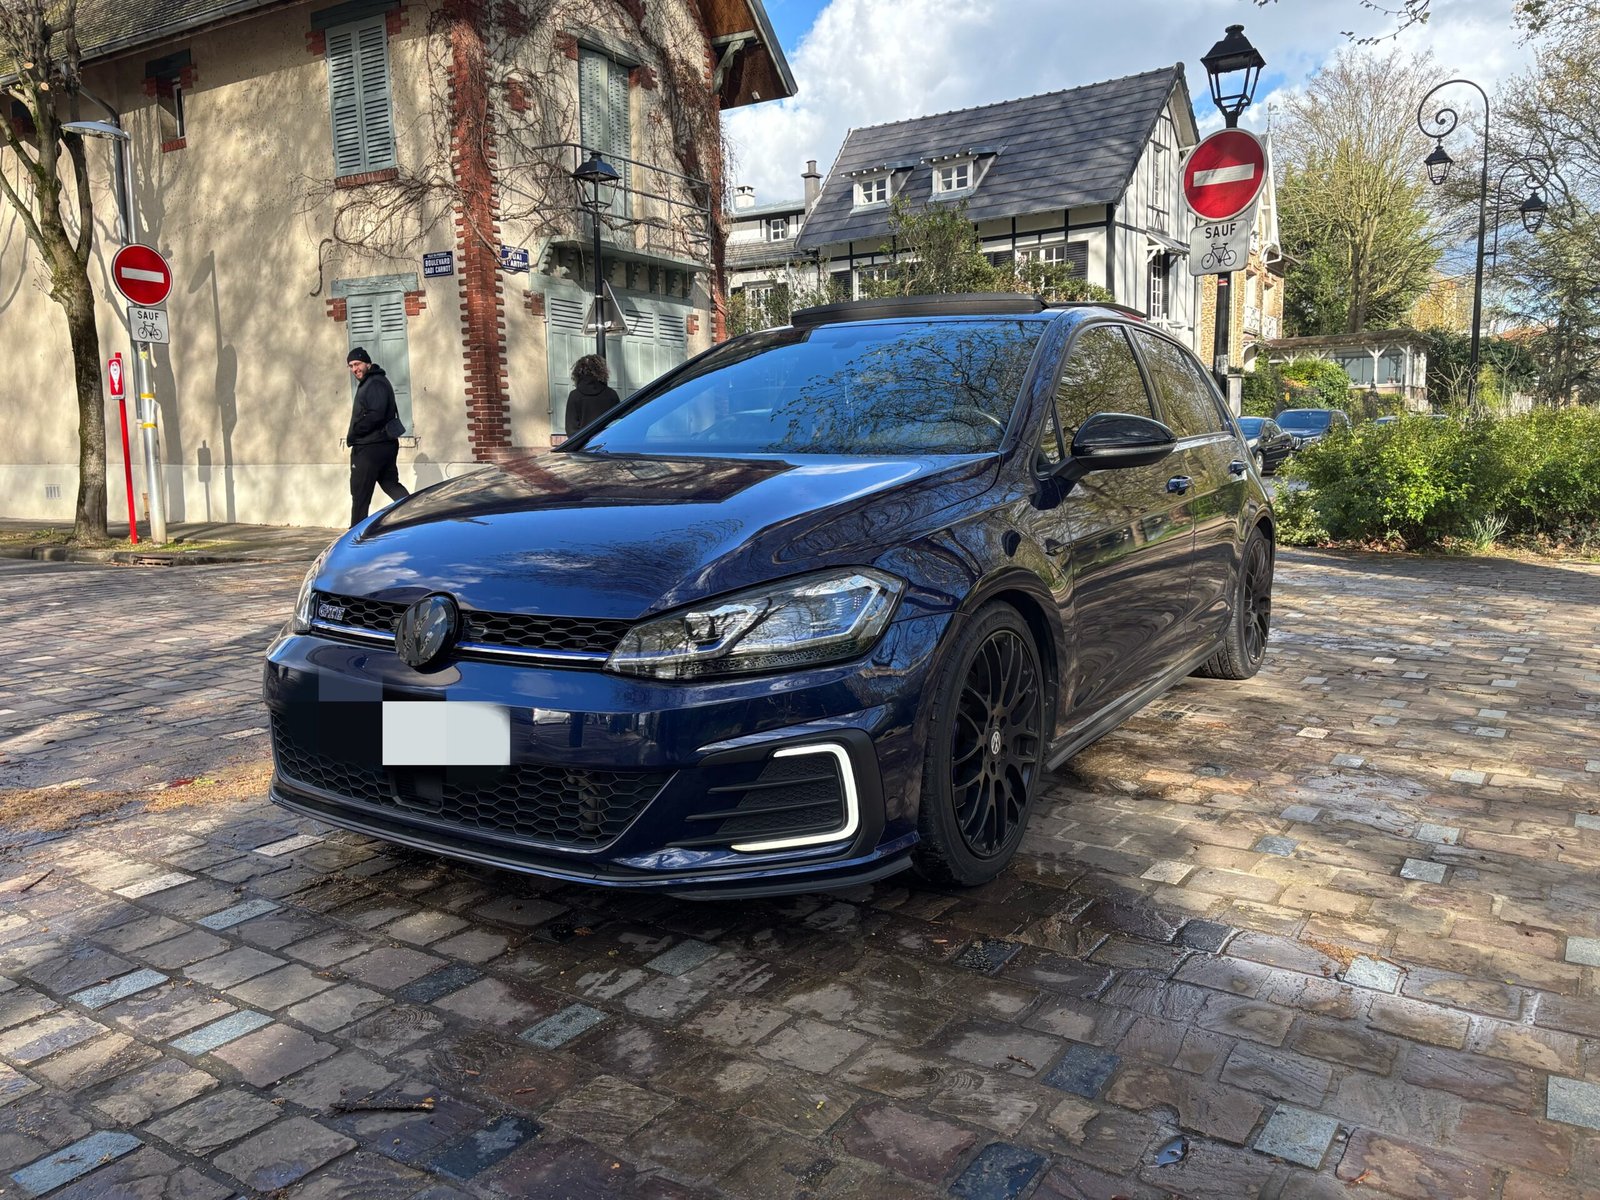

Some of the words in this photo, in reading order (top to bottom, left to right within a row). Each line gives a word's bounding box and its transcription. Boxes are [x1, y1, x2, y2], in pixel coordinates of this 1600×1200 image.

[1205, 223, 1237, 239] SAUF
[425, 257, 450, 267] BOULEVARD
[137, 310, 159, 320] SAUF
[319, 603, 346, 620] GTE
